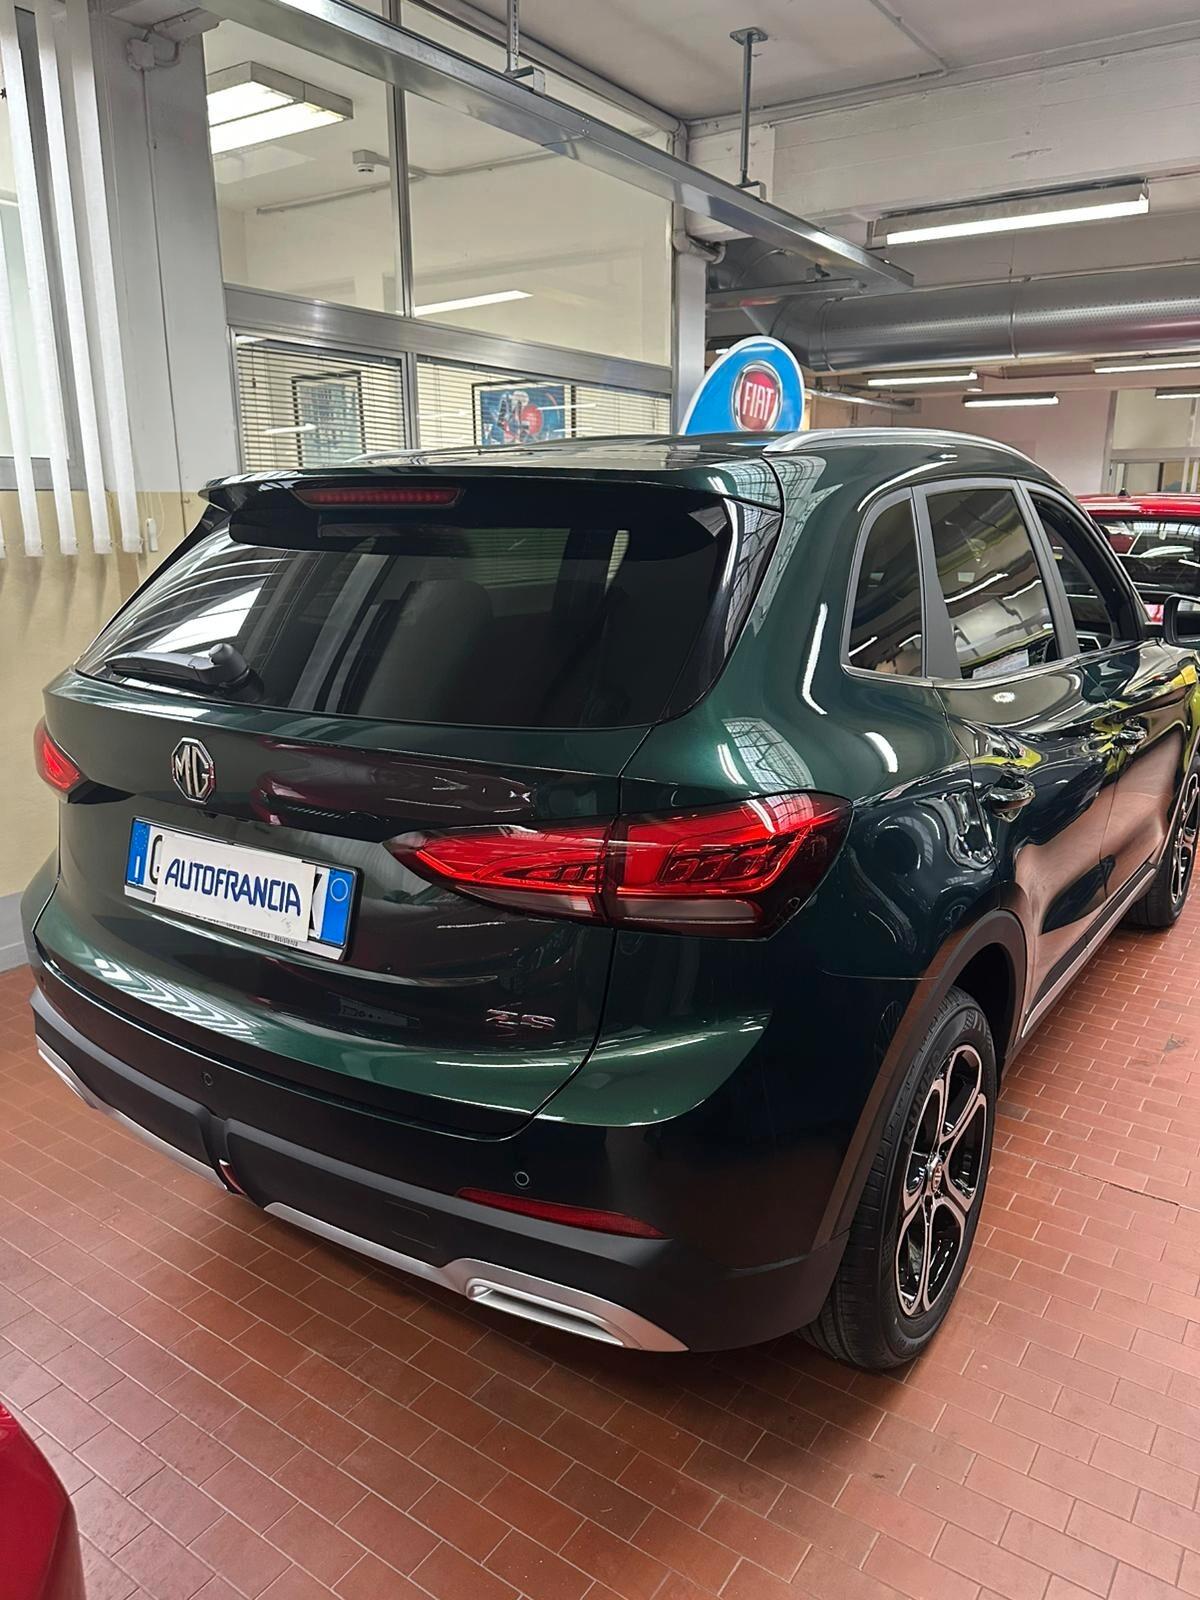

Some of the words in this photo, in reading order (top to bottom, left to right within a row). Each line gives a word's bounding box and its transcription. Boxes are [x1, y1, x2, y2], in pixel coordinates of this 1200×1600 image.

[742, 381, 775, 421] FIAT
[175, 744, 210, 798] MG
[164, 858, 301, 917] AUTOFRANCIA
